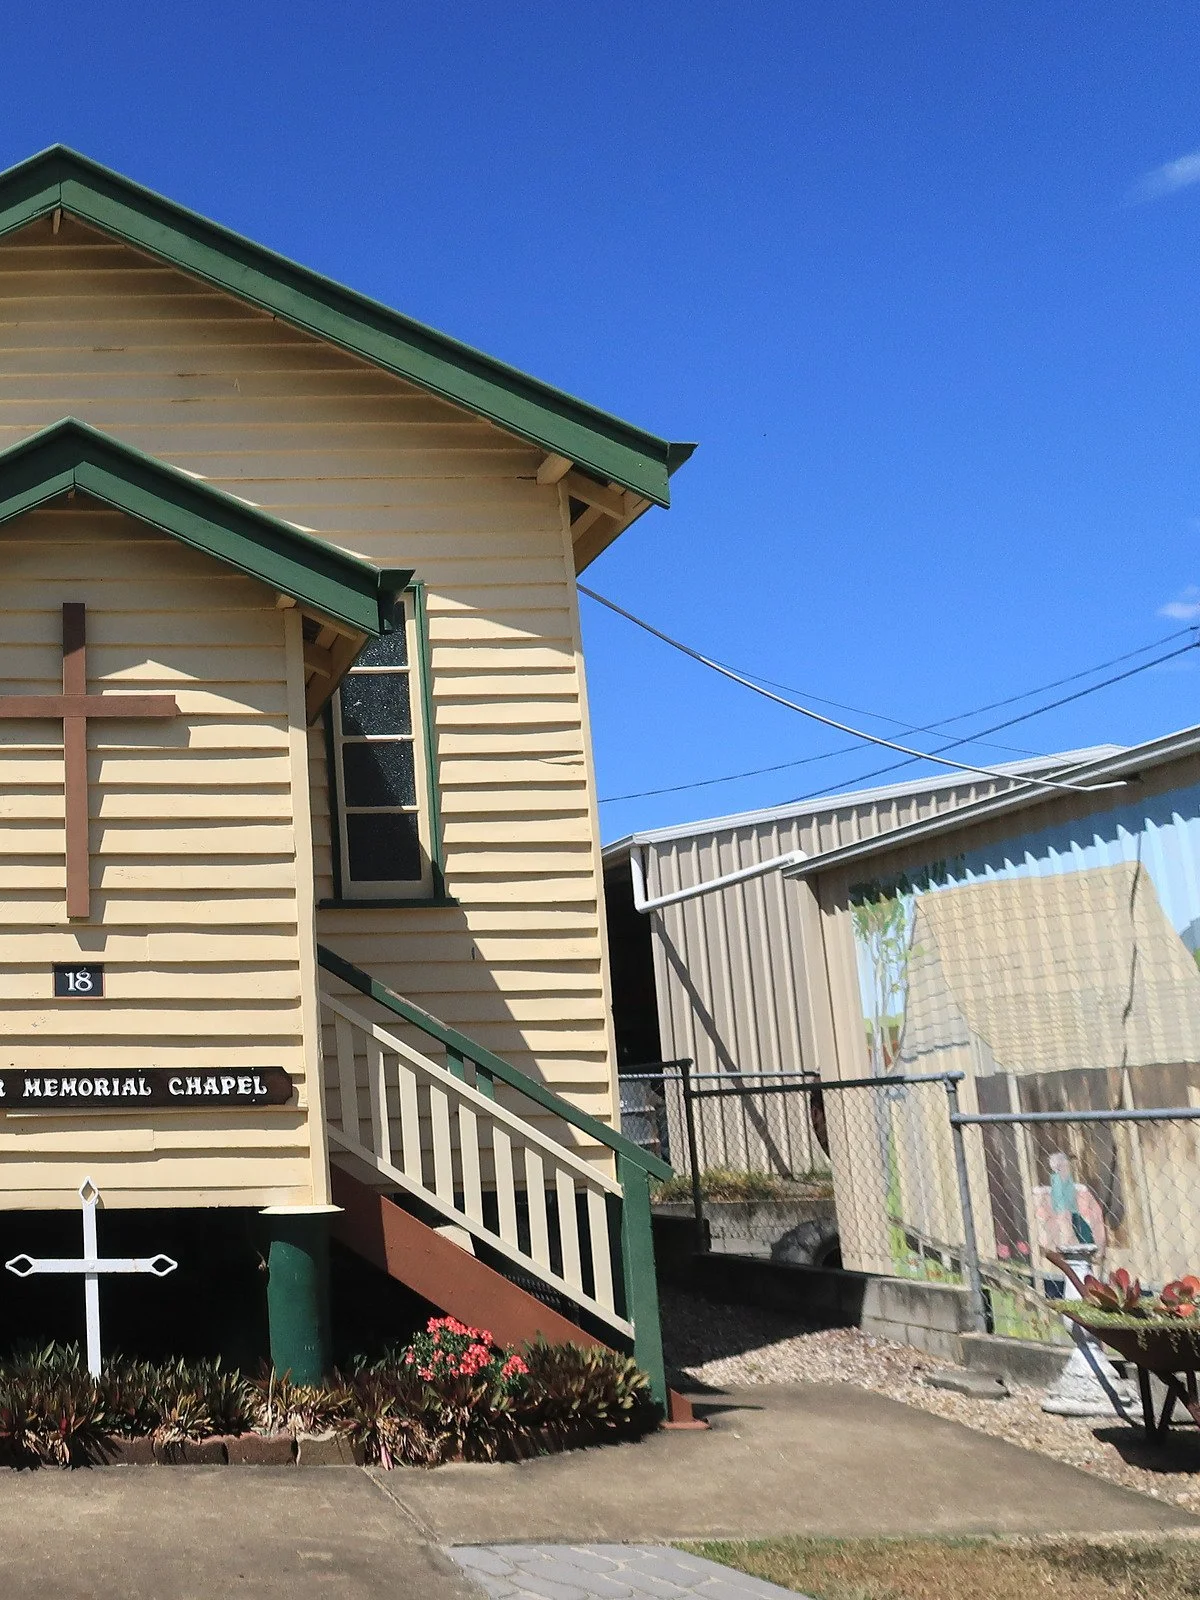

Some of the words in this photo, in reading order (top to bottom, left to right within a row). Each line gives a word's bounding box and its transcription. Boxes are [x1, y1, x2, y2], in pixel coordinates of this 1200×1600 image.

[65, 971, 94, 991] 18
[22, 1077, 152, 1098] MEMORIAL
[168, 1075, 268, 1096] CHAPEL
